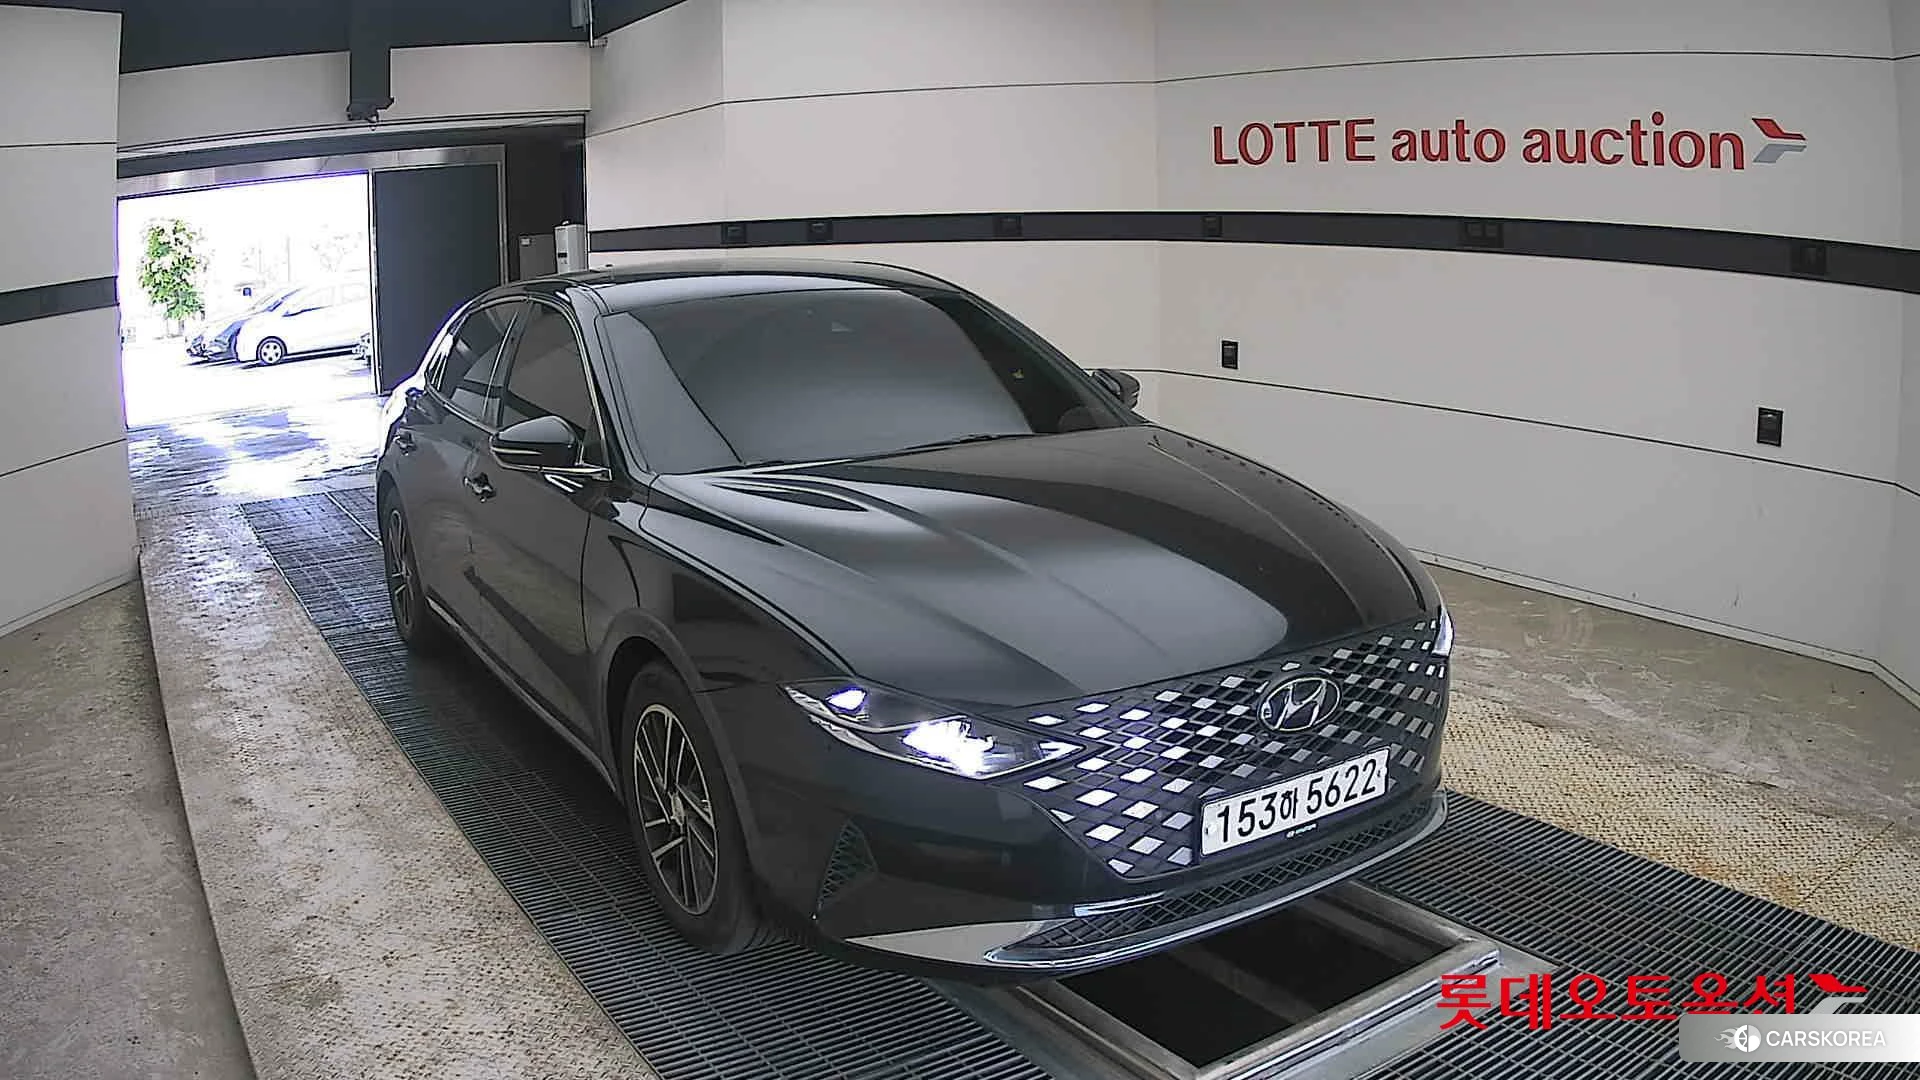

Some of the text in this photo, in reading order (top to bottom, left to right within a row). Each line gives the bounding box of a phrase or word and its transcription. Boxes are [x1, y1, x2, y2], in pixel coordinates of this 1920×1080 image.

[1213, 111, 1746, 171] LOTTE auto auction
[1217, 758, 1378, 843] 153하 5622
